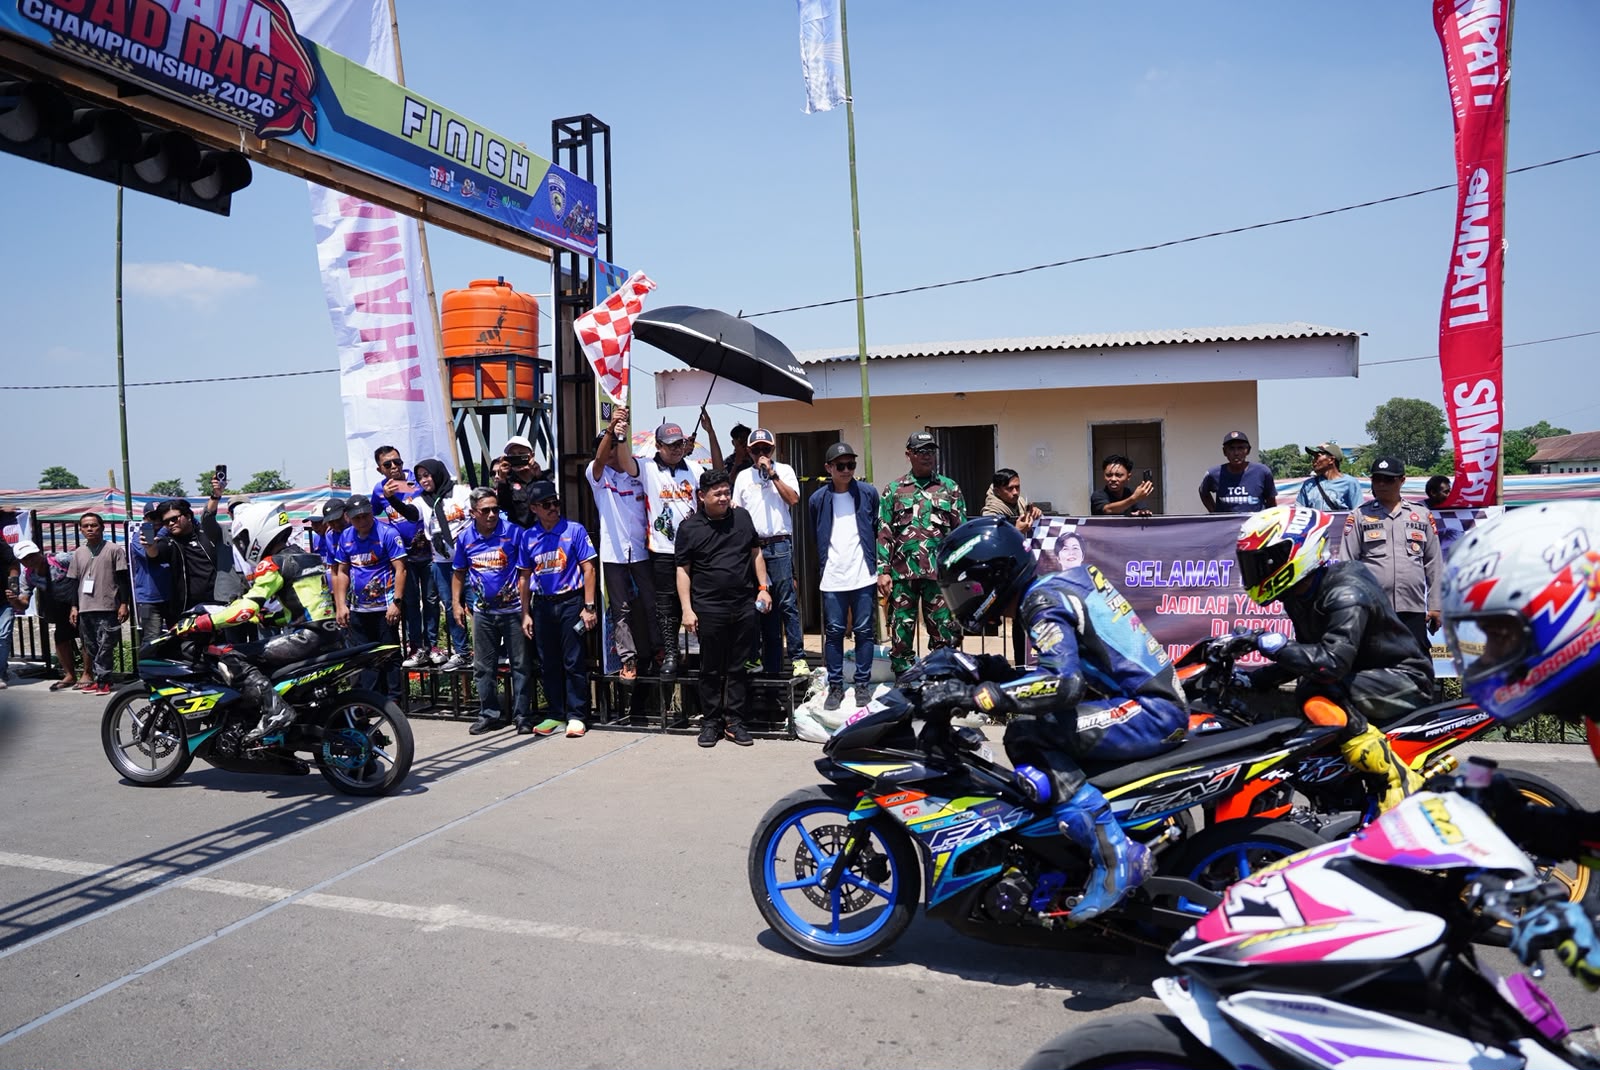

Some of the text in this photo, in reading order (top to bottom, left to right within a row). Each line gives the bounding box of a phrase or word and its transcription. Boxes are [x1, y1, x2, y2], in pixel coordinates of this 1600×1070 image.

[22, 0, 275, 119] CHAMPIONSHIP 2026
[183, 18, 299, 106] RACE
[1454, 0, 1501, 107] MPATI
[402, 95, 530, 190] FINISH
[1448, 167, 1490, 329] SIMPATI
[1453, 378, 1499, 502] SIMPAT
[1227, 486, 1249, 496] TCL
[1125, 560, 1234, 588] SELAMAT
[1156, 594, 1229, 615] JADILAH
